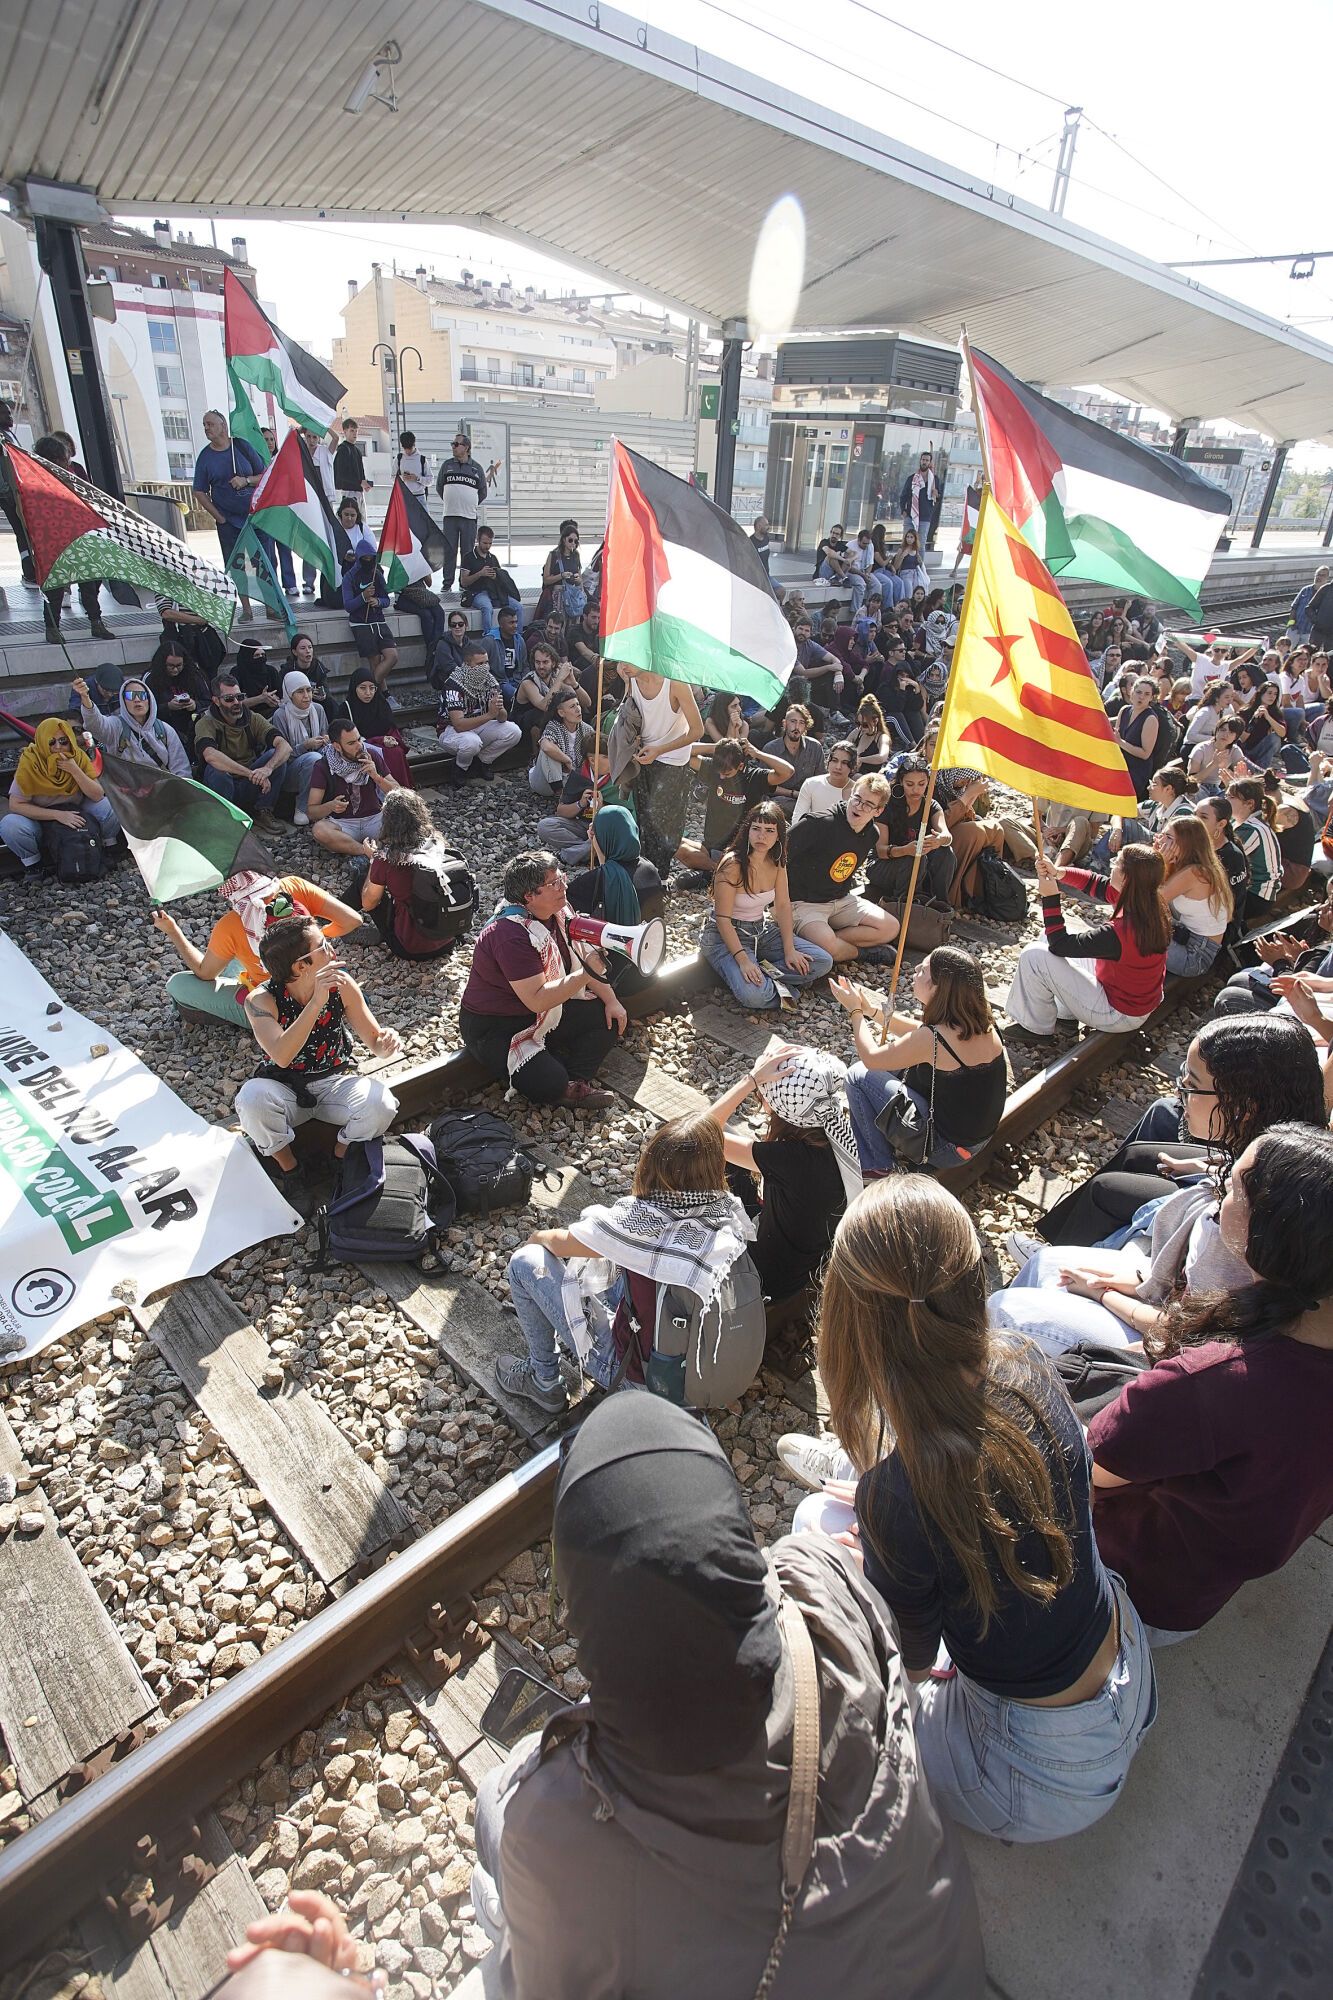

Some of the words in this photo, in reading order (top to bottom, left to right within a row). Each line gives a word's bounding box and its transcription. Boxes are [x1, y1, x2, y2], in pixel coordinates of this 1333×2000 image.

[1203, 451, 1225, 460] Girona
[446, 474, 477, 486] STAMFORD
[18, 1065, 81, 1111] DEL
[88, 1146, 148, 1183] AL
